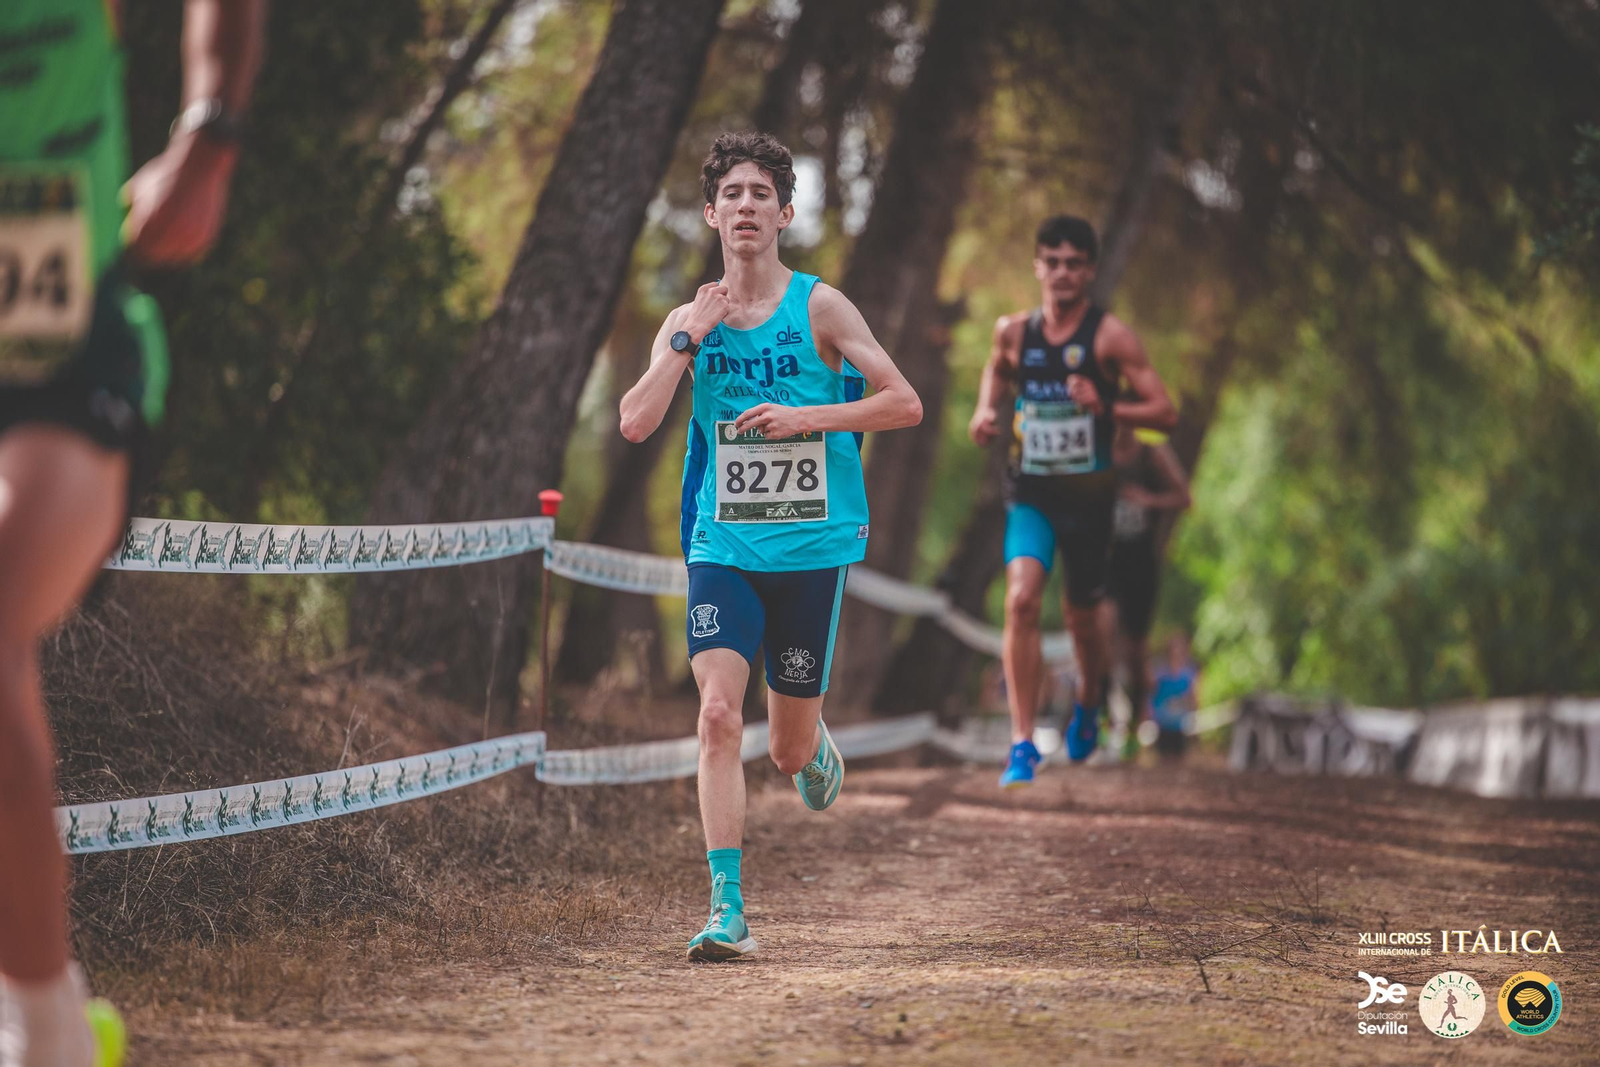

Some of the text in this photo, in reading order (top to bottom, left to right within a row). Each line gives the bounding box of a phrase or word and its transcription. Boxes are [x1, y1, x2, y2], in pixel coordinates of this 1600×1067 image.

[726, 459, 819, 494] 8278
[788, 647, 810, 657] CMD
[785, 669, 809, 679] NERJA
